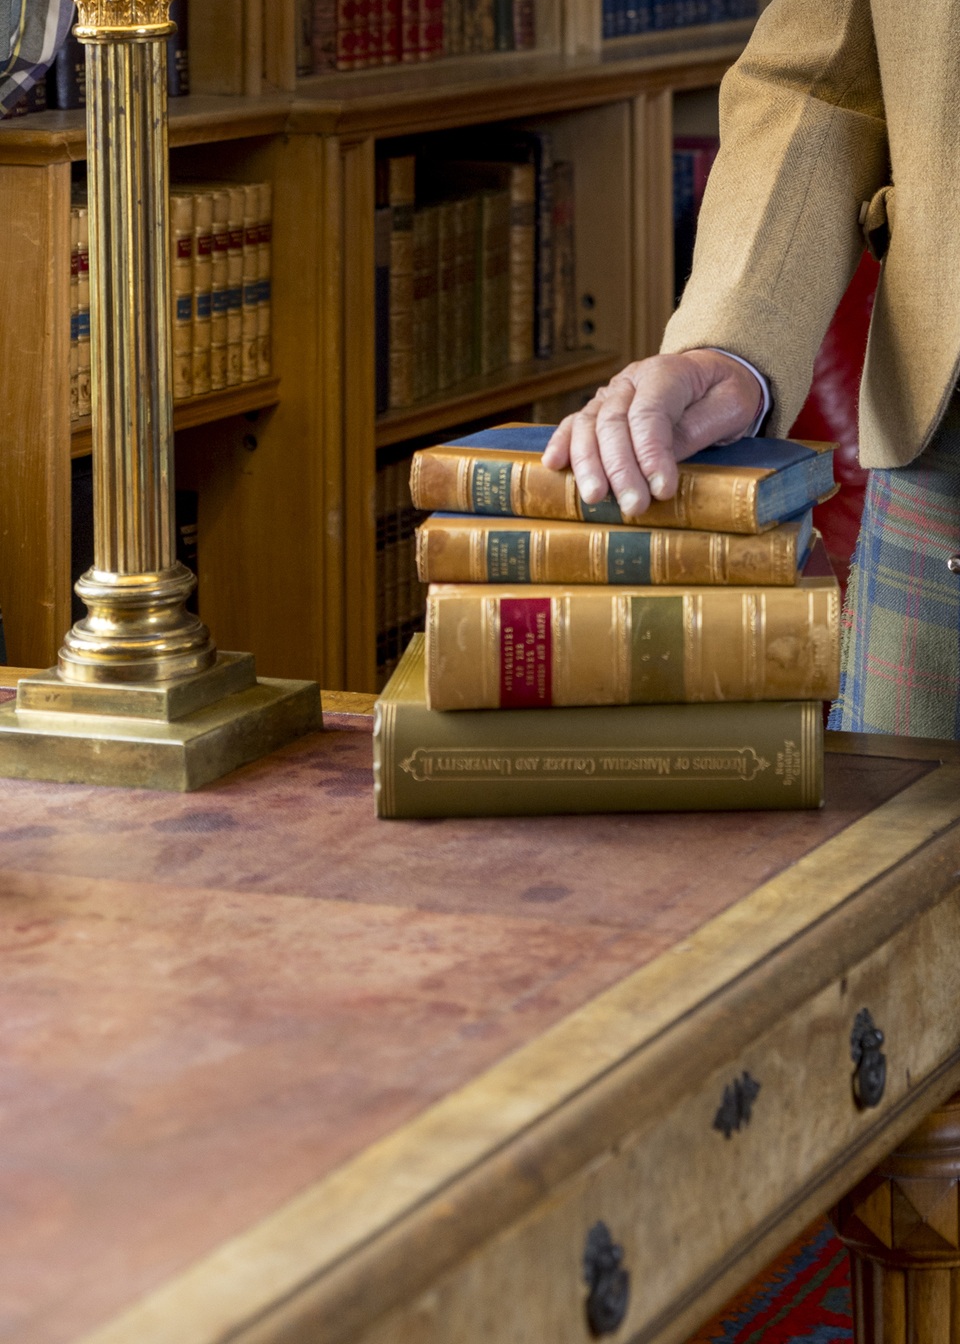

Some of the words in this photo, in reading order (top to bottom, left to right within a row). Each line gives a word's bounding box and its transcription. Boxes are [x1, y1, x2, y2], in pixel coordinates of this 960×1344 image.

[525, 632, 535, 645] OF
[515, 643, 524, 661] THE
[536, 644, 546, 660] AND
[515, 665, 524, 678] OF
[436, 757, 512, 775] UNIVERSITY
[515, 757, 539, 771] AND
[543, 757, 596, 775] COLLEGE
[600, 757, 670, 775] MARISCHAL
[673, 757, 690, 770] OF
[692, 757, 747, 775] RECORDS
[775, 752, 784, 775] New
[783, 739, 796, 786] Spalding
